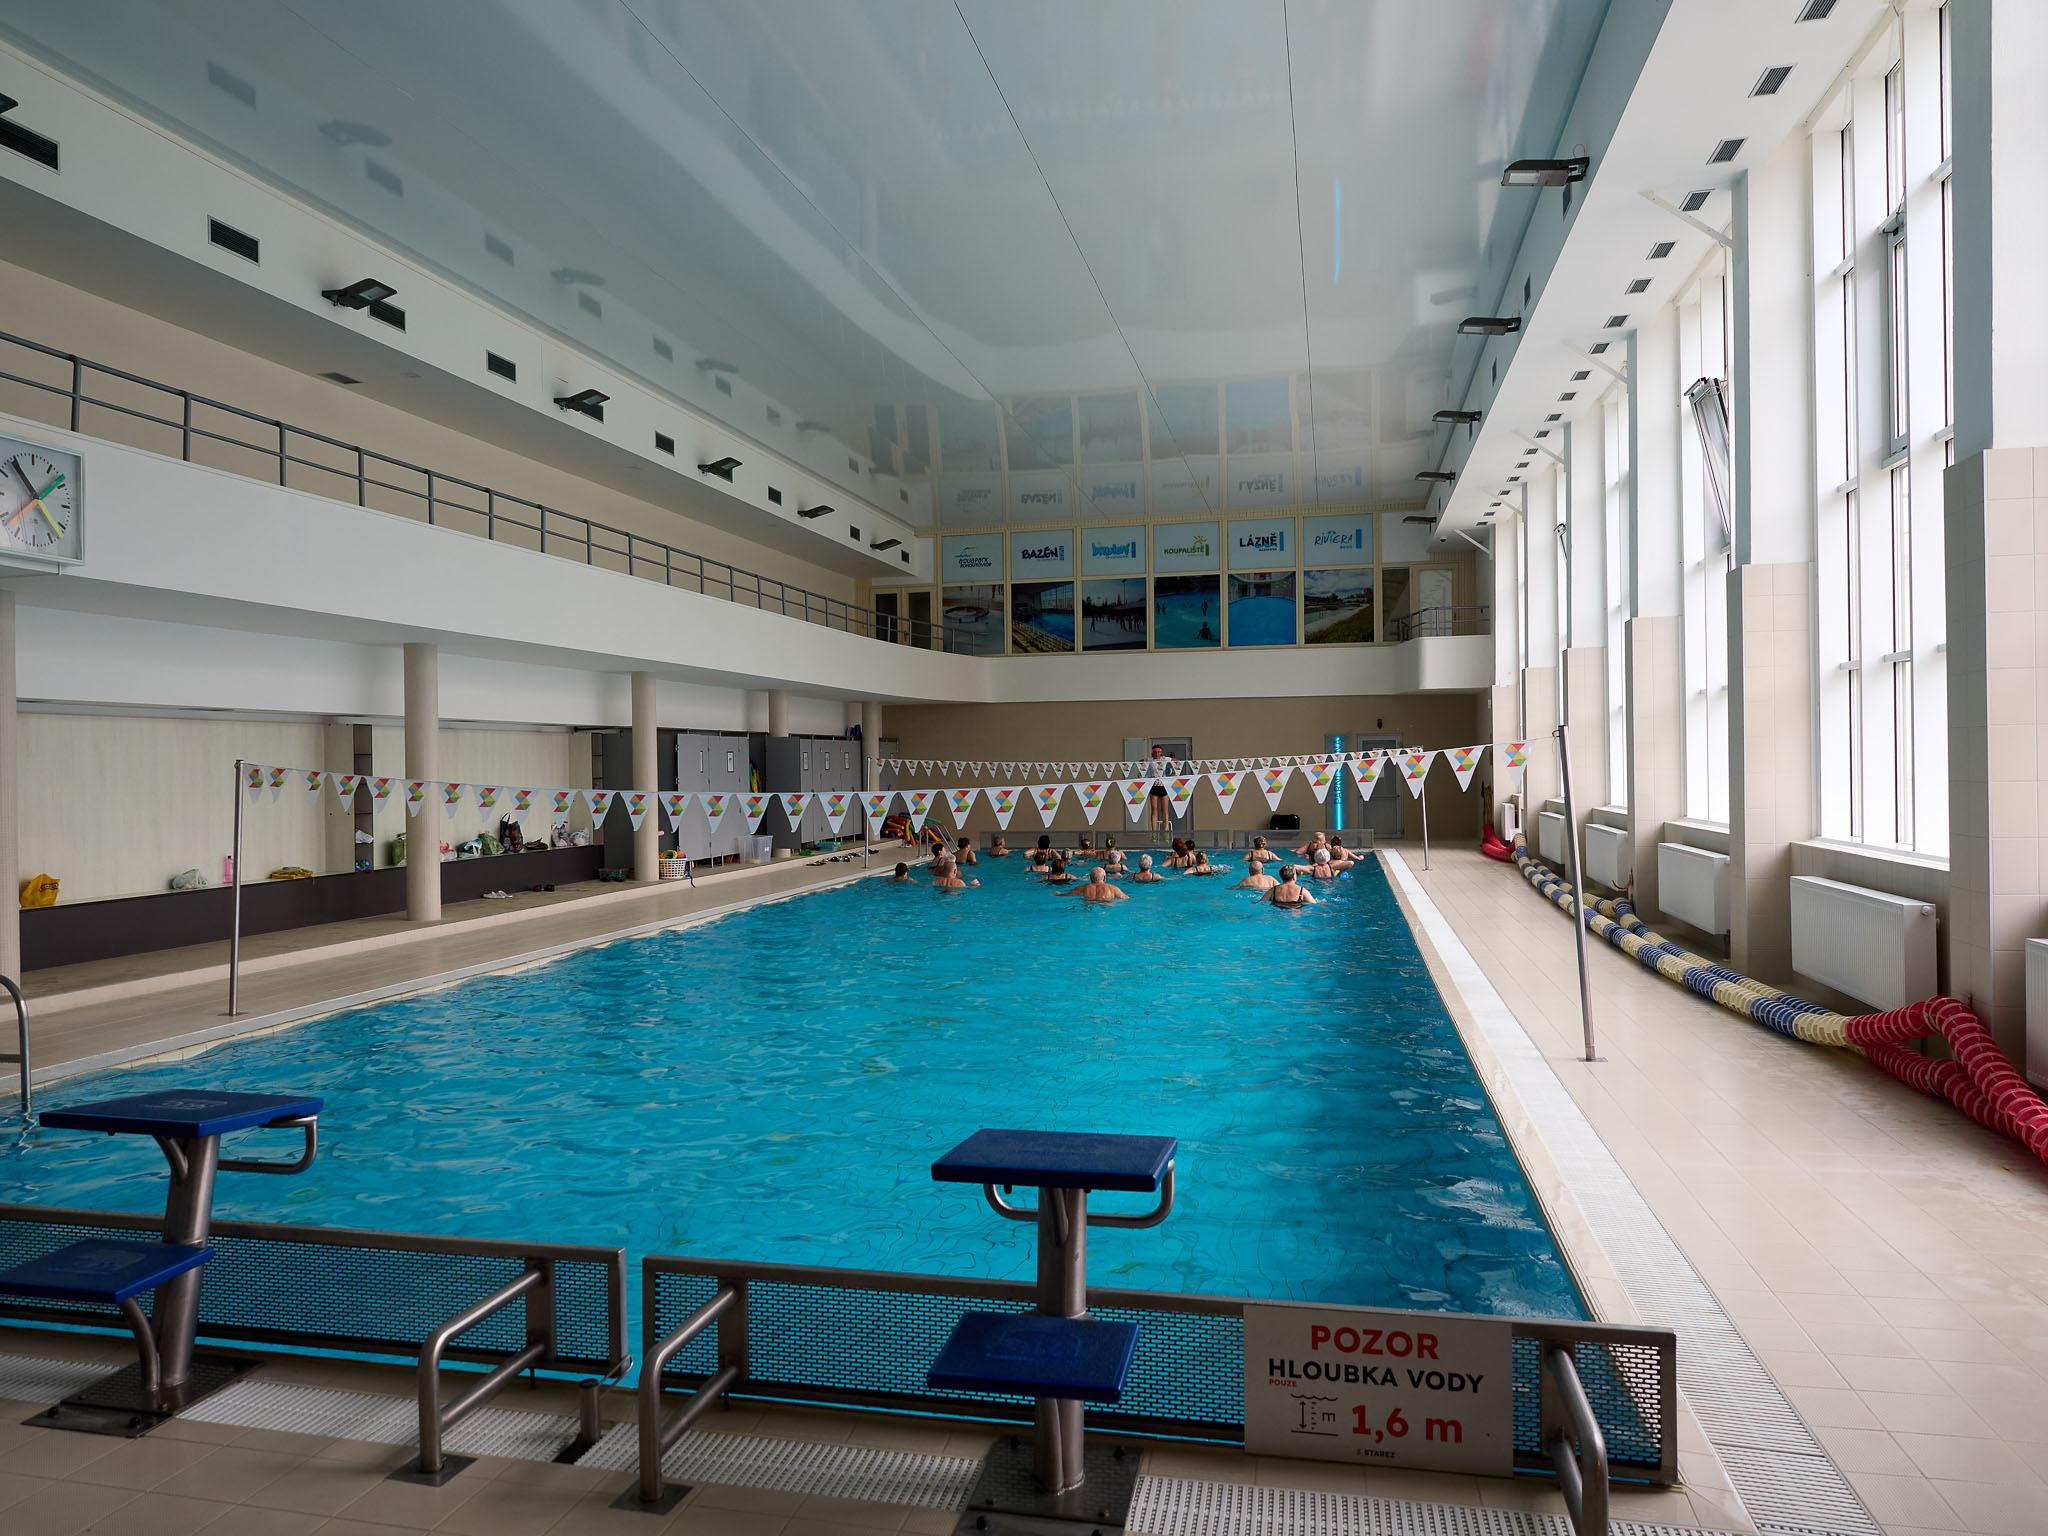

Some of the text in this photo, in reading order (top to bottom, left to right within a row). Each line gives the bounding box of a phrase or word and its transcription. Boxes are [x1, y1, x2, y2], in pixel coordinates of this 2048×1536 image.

[1239, 532, 1277, 548] LÁZNĚ
[1021, 546, 1059, 560] BAZÉN
[1164, 545, 1205, 556] KOUPALIŠTĚ
[1311, 1325, 1440, 1360] POZOR
[1268, 1358, 1484, 1393] HLOUBKA VODY
[1269, 1378, 1297, 1388] POUZE
[1321, 1410, 1336, 1422] m
[1351, 1404, 1463, 1444] 1,6 m
[1364, 1449, 1396, 1459] STAREZ
